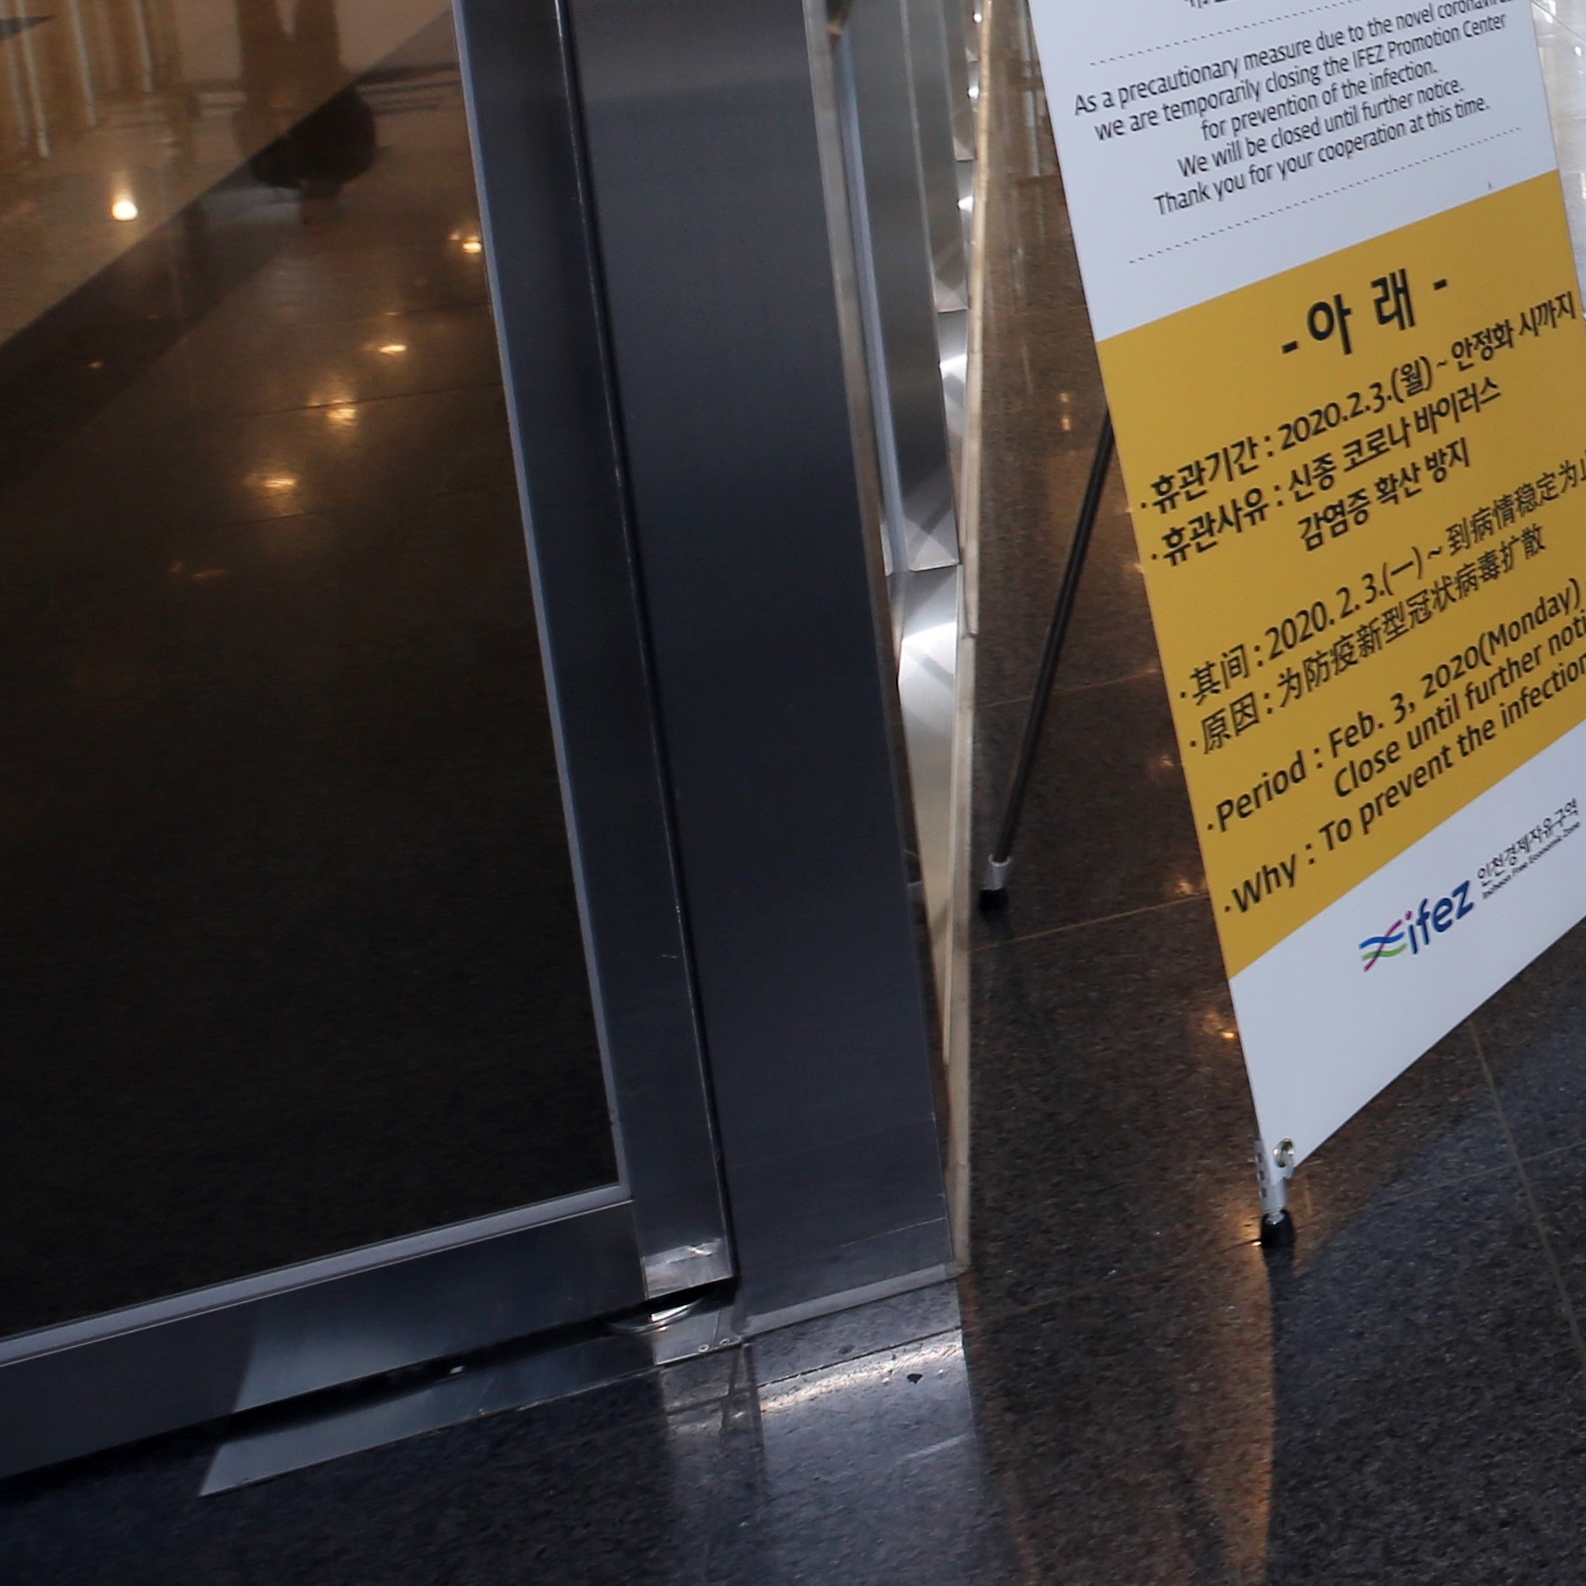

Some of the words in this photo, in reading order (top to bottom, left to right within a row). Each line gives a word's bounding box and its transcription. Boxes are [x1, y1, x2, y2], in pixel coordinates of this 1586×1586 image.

[1074, 91, 1097, 116] As
[1102, 90, 1115, 109] a
[1117, 55, 1239, 110] precautionary
[1243, 40, 1311, 72] measure
[1316, 28, 1345, 55] due
[1347, 24, 1365, 48] to
[1368, 17, 1392, 43] the
[1396, 7, 1435, 35] novel
[1095, 118, 1126, 142] we
[1131, 110, 1159, 132] are
[1162, 81, 1262, 125] temporarily
[1267, 66, 1319, 100] closing
[1323, 57, 1349, 81] the
[1352, 45, 1384, 71] IFEZ
[1387, 26, 1461, 62] Promotion
[1463, 11, 1508, 38] Center
[1200, 118, 1226, 143] for
[1231, 93, 1320, 137] prevention
[1323, 87, 1339, 110] of
[1341, 78, 1367, 103] the
[1370, 57, 1439, 93] infection.
[1154, 182, 1211, 218] Thank
[1214, 173, 1246, 203] you
[1250, 164, 1273, 186] for
[1277, 150, 1314, 182] your
[1317, 123, 1407, 167] cooperation
[1409, 114, 1426, 135] at
[1427, 106, 1453, 127] this
[1455, 95, 1491, 118] time.
[1178, 152, 1209, 180] We
[1212, 140, 1243, 167] will
[1246, 133, 1268, 157] be
[1271, 119, 1321, 150] closed
[1325, 106, 1360, 135] until
[1363, 93, 1416, 125] further
[1418, 78, 1464, 105] notice.
[1451, 319, 1515, 372] 안정화
[1518, 291, 1577, 338] 시까지
[1289, 454, 1336, 504] 신종
[1342, 418, 1411, 475] 코로나
[1415, 376, 1502, 436] 바이러스
[1297, 494, 1370, 551] 감염증
[1375, 466, 1421, 508] 확산
[1423, 437, 1471, 484] 방지
[1328, 709, 1384, 760] Feb.
[1392, 692, 1415, 725] 3,
[1332, 738, 1400, 799] Close
[1407, 694, 1462, 752] until
[1465, 651, 1542, 715] further
[1318, 820, 1352, 854] To
[1359, 746, 1454, 834] prevent
[1458, 721, 1496, 759] the
[1477, 798, 1578, 887] 인천경제자유구역
[1406, 880, 1475, 954] ifez
